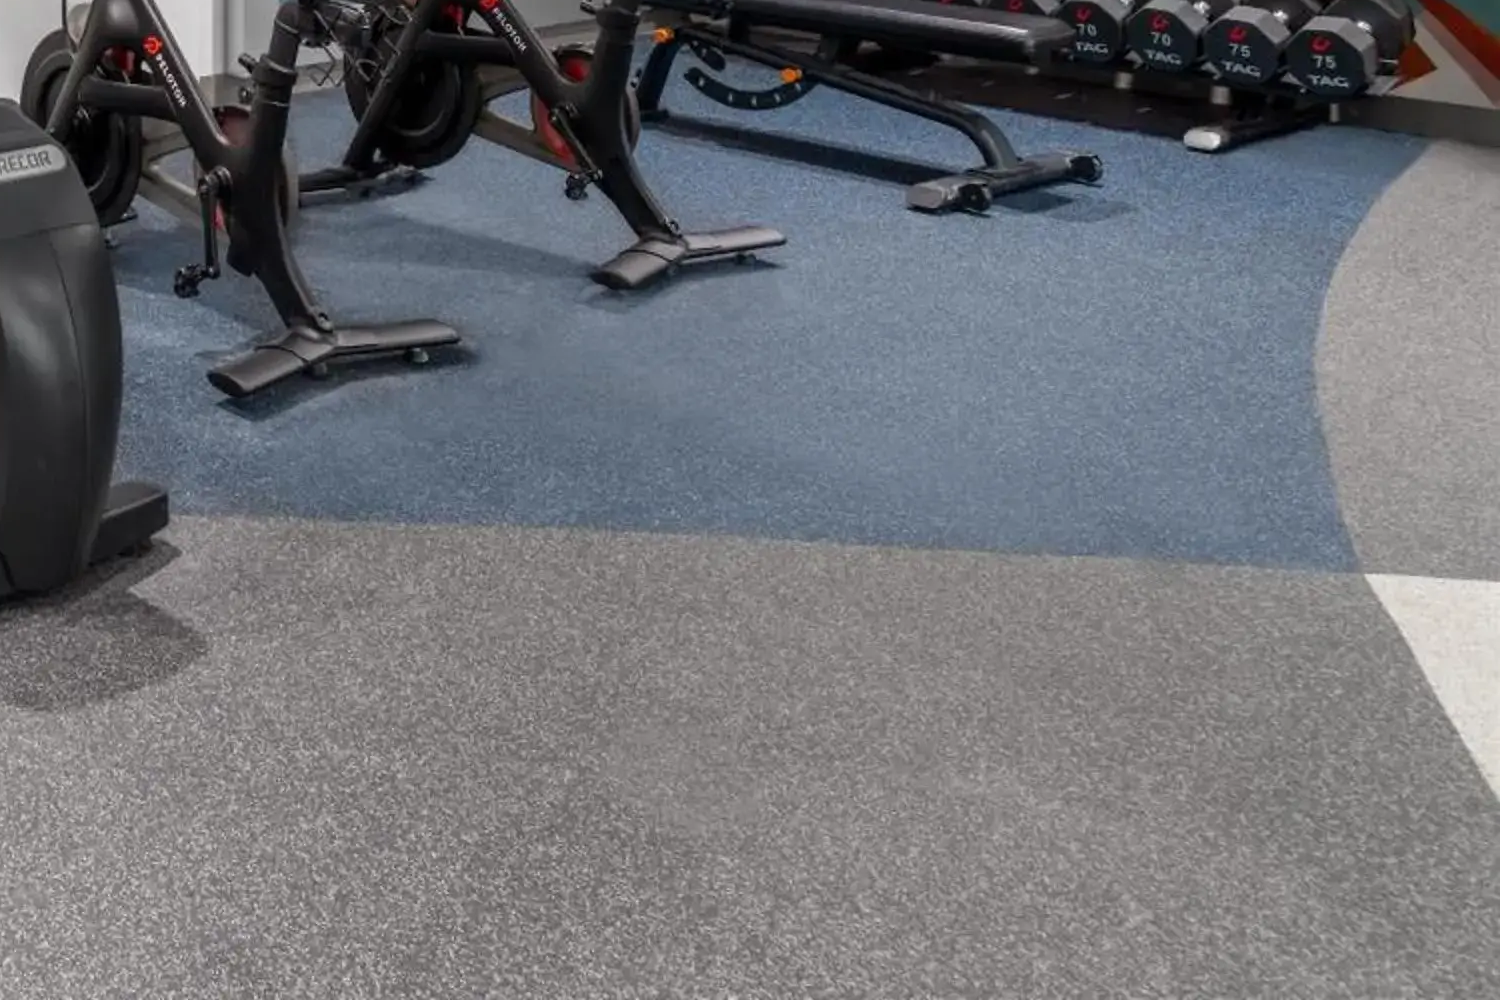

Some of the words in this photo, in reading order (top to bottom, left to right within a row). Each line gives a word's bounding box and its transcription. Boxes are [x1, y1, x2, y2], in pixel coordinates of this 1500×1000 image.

[492, 7, 527, 53] PELOTON
[1076, 23, 1097, 37] 70
[1150, 31, 1171, 47] 70
[1074, 41, 1109, 54] TAG
[1228, 43, 1251, 58] 75
[1144, 49, 1182, 65] TAG
[1311, 55, 1337, 69] 75
[1220, 60, 1261, 77] TAG
[155, 53, 187, 108] PELOTON
[1306, 73, 1349, 88] TAG
